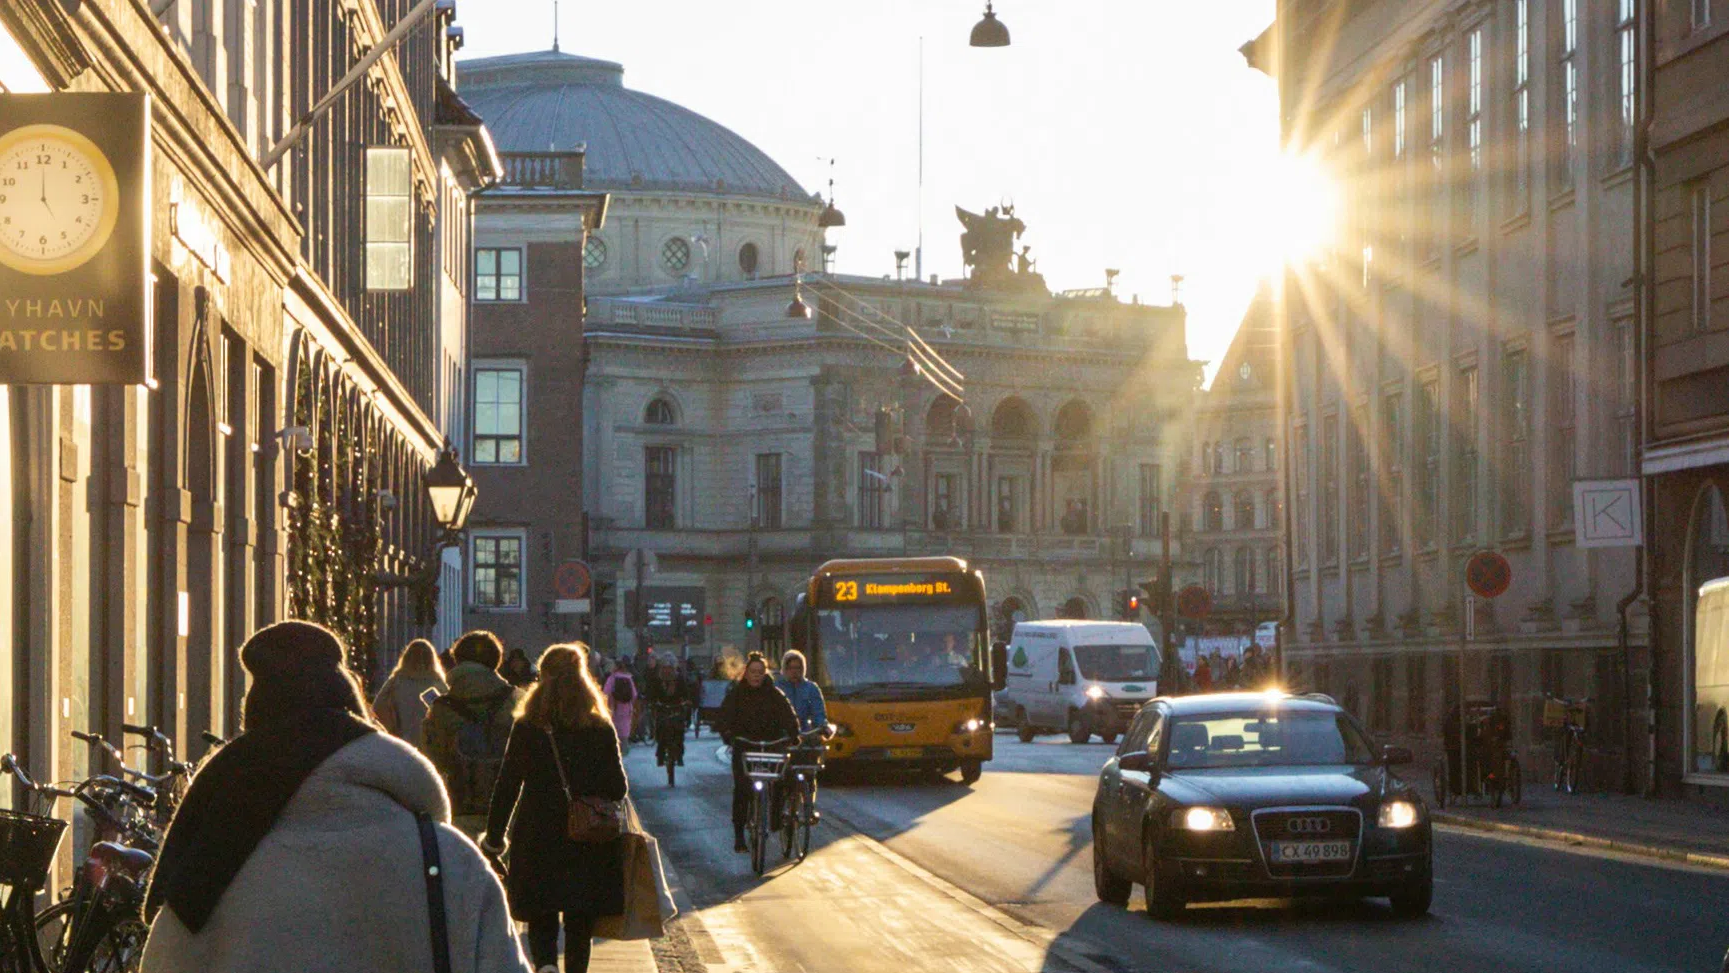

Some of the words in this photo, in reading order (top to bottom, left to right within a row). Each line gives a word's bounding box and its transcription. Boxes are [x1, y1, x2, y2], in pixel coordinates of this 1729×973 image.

[35, 154, 52, 165] 12
[16, 161, 29, 170] 11
[62, 161, 67, 169] 1
[2, 177, 16, 187] 10
[75, 175, 82, 183] 2
[81, 194, 89, 205] 3
[4, 216, 12, 225] 8
[75, 215, 82, 224] 4
[19, 230, 26, 238] 7
[61, 231, 67, 239] 5
[39, 235, 47, 245] 6
[1592, 495, 1626, 533] K
[835, 581, 858, 601] 23
[866, 583, 933, 596] Klampenborg
[1282, 844, 1300, 858] CX
[1304, 844, 1320, 858] 49
[1323, 844, 1348, 858] 898
